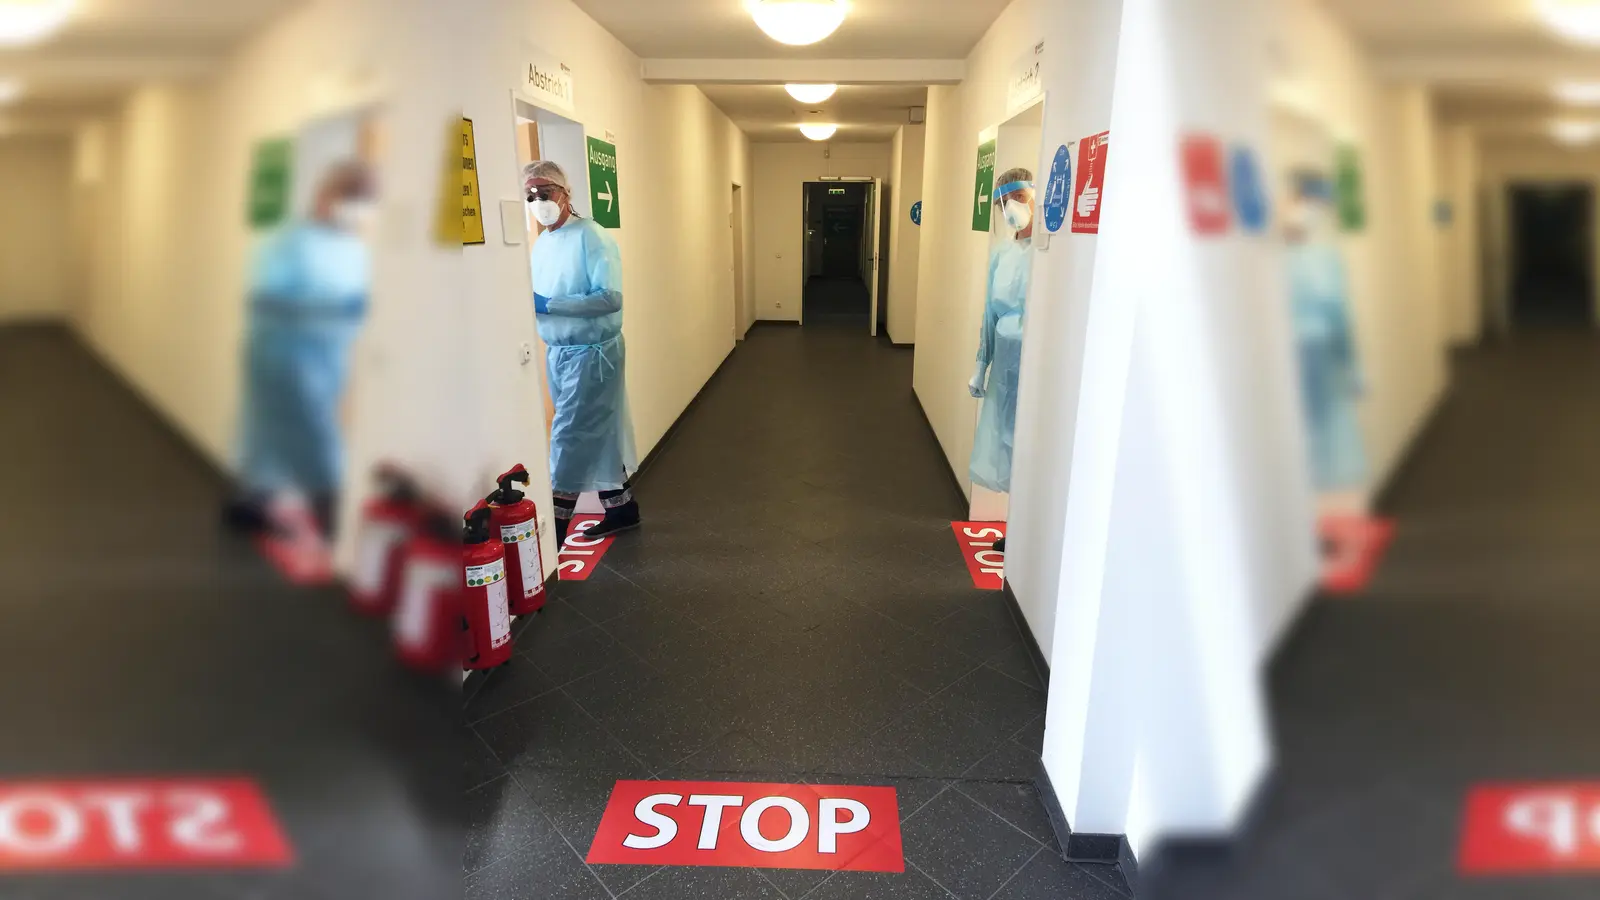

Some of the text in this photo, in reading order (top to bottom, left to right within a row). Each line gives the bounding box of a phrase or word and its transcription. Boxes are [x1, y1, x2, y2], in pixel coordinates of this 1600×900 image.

[528, 62, 563, 98] Abstrich
[590, 144, 615, 173] Ausgang
[622, 793, 871, 854] STOP
